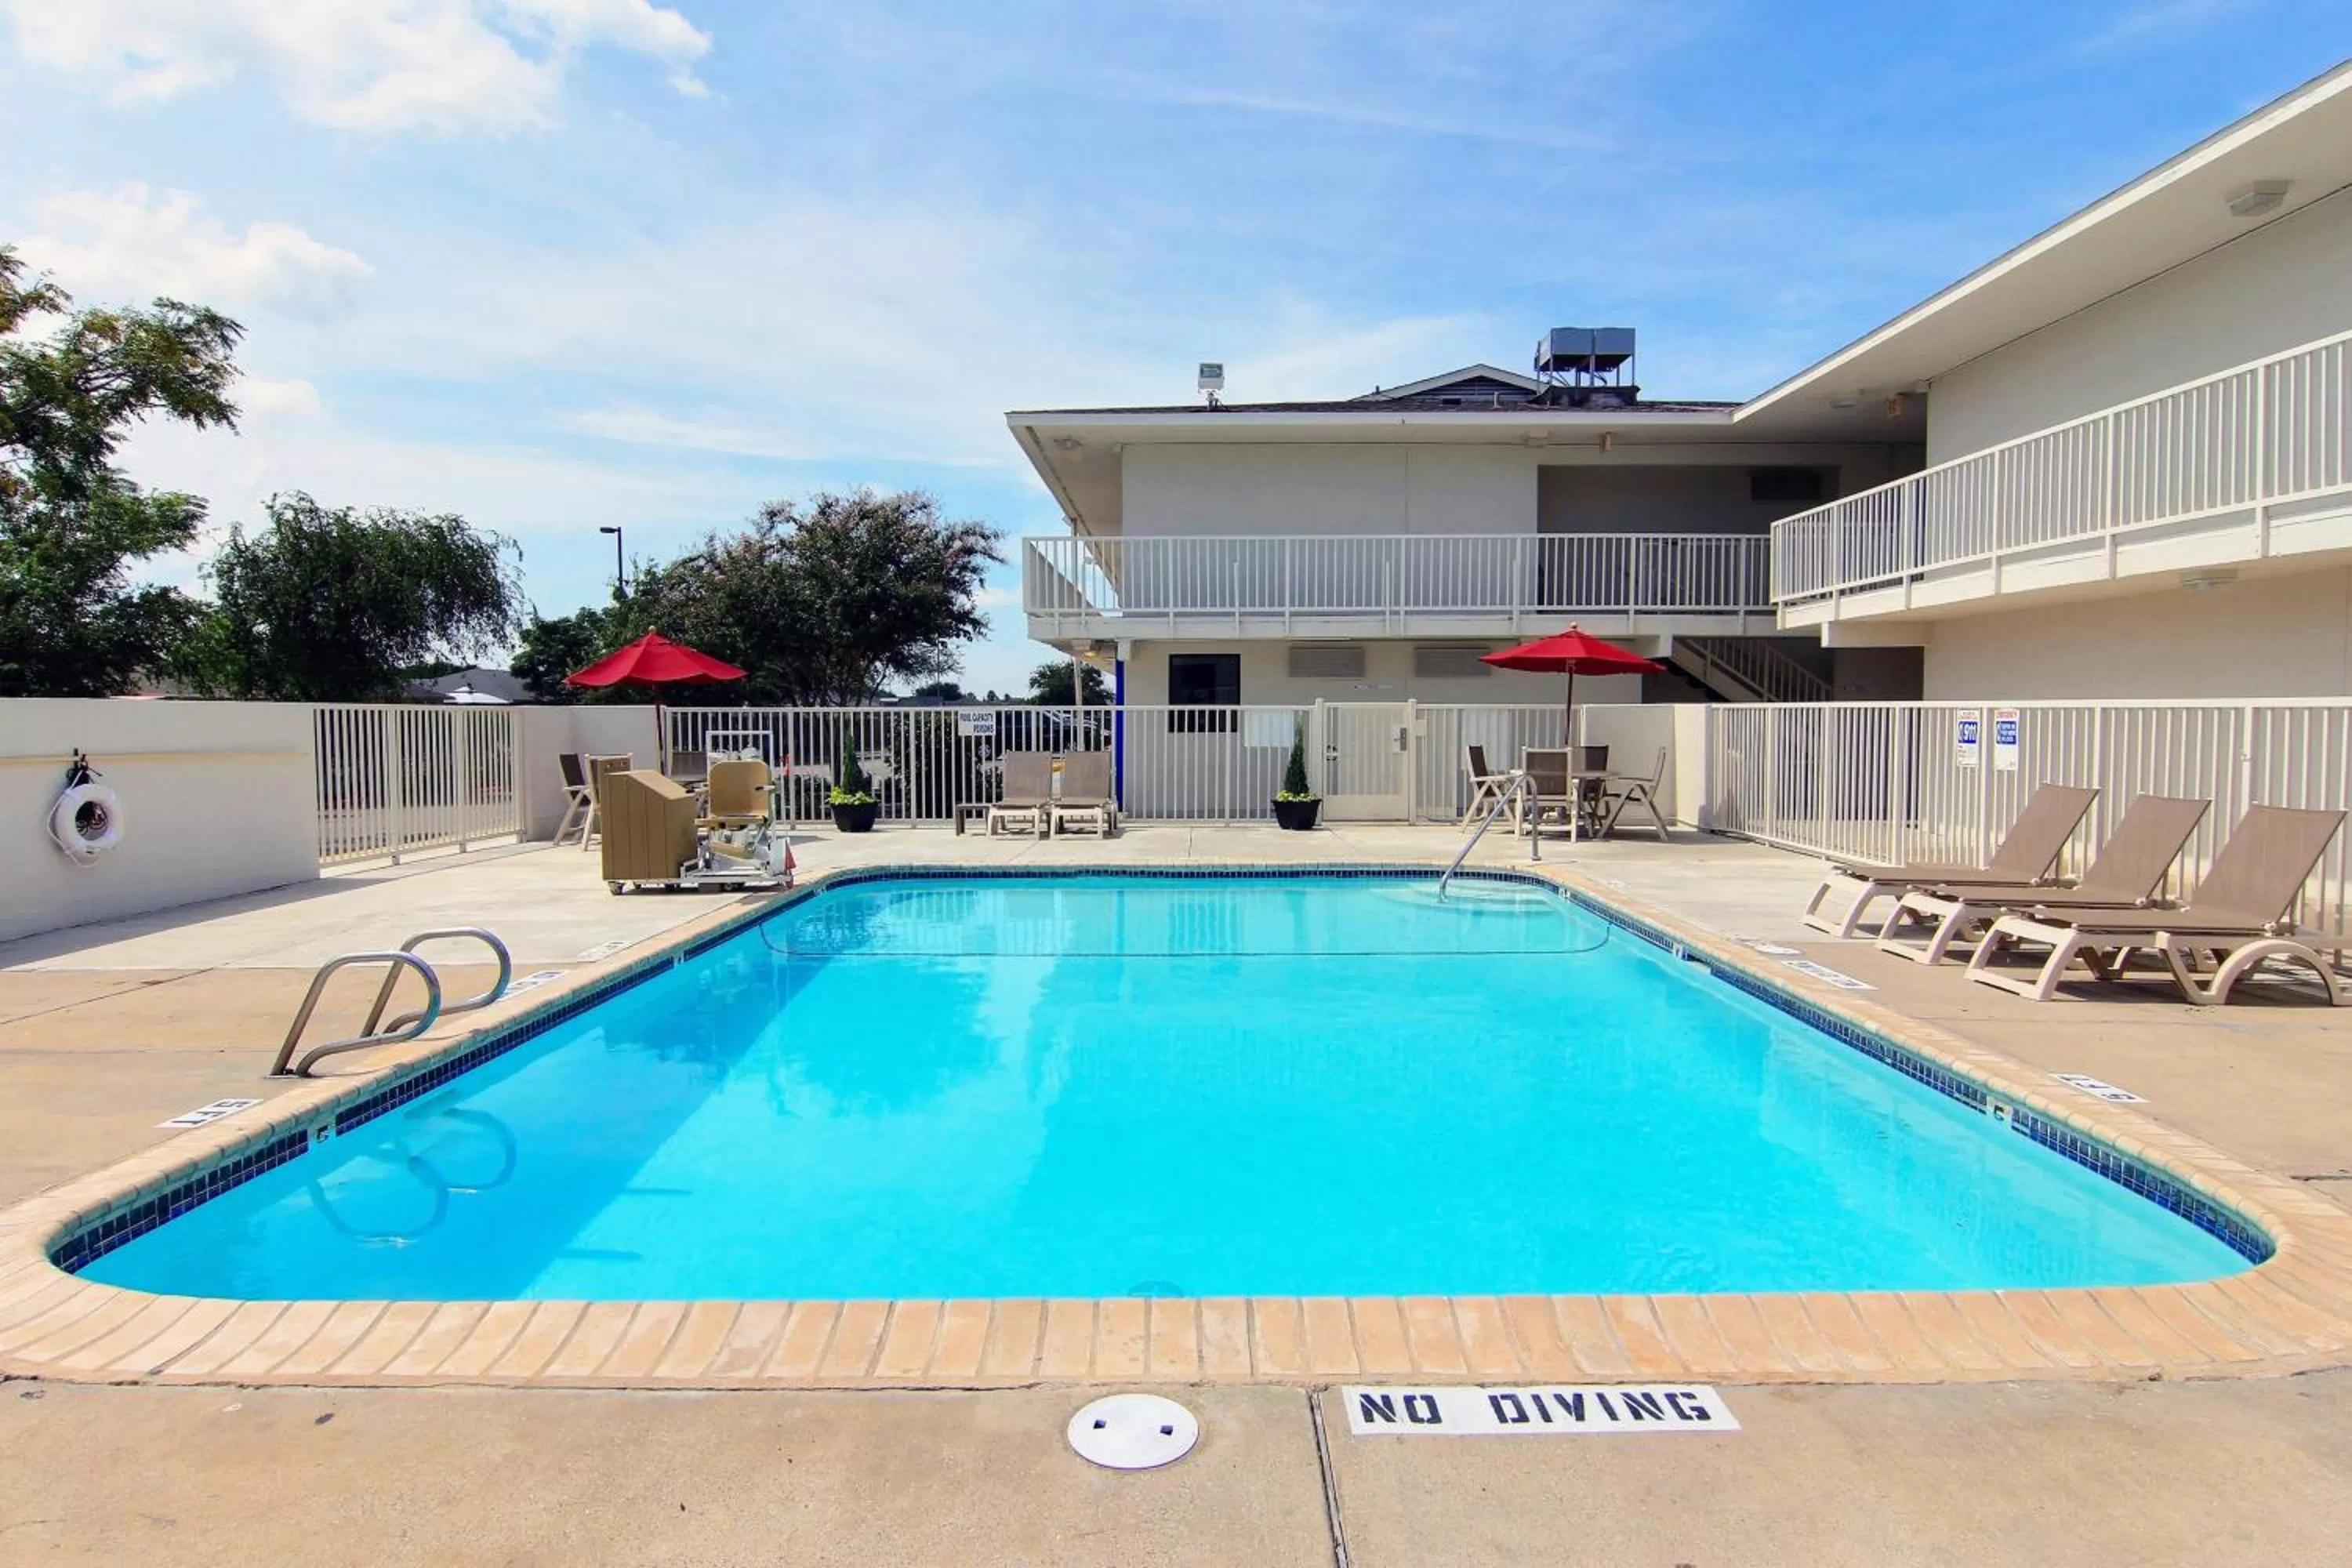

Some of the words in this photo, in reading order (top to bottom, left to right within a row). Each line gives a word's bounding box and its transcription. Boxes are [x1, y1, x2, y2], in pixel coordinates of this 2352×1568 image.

[1964, 723, 1977, 741] 911
[1359, 1392, 1443, 1425] NO
[1488, 1391, 1712, 1425] DIVING
